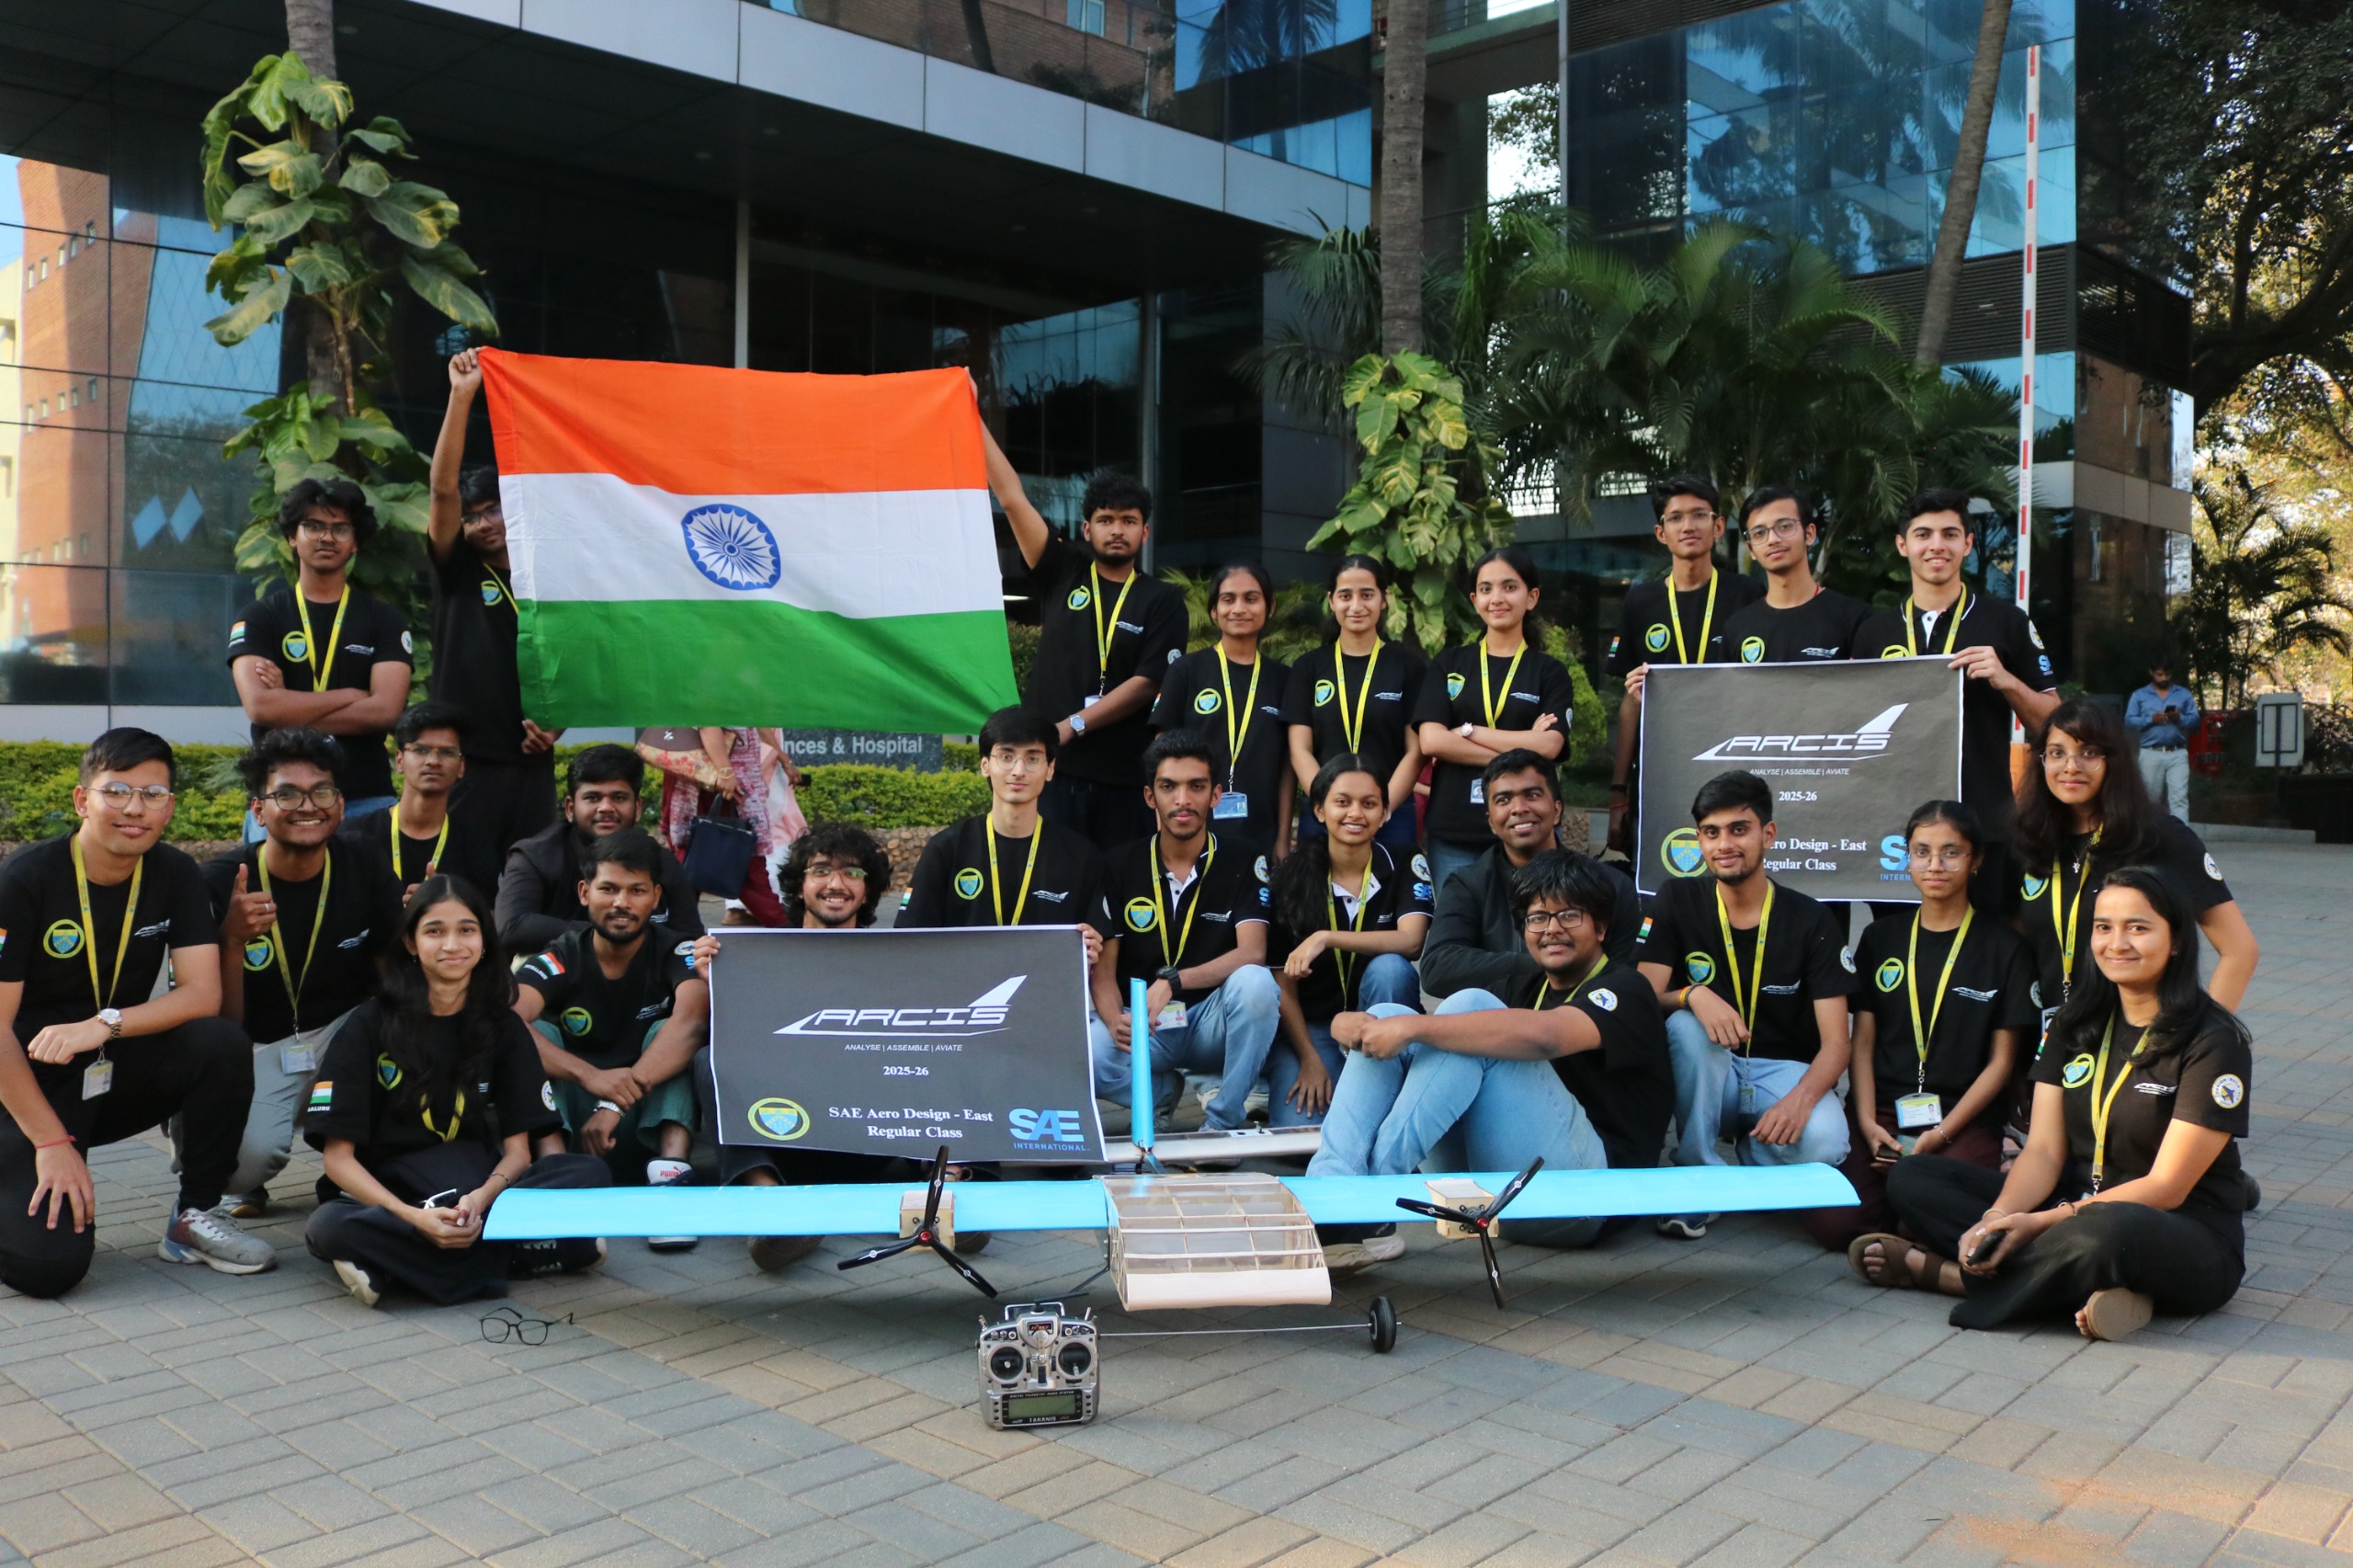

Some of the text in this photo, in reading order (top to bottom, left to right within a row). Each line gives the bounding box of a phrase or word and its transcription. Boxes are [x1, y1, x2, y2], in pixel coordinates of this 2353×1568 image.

[832, 737, 845, 755] &
[852, 736, 923, 758] Hospital
[1725, 734, 1892, 752] ARCIS
[1779, 791, 1818, 801] 2025-26
[1770, 840, 1787, 850] ro
[1790, 838, 1829, 853] Design
[1840, 839, 1867, 851] East
[1804, 858, 1837, 871] Class
[813, 1006, 1010, 1027] ARCIS
[844, 1043, 881, 1051] ANALYSE
[886, 1044, 929, 1052] ASSEMBLE
[935, 1044, 963, 1052] AVIATE
[882, 1065, 929, 1076] 2025-26
[828, 1107, 863, 1119] SAE
[867, 1108, 900, 1119] Aero
[904, 1108, 951, 1122] Design
[962, 1108, 994, 1122] East
[1008, 1108, 1085, 1142] SAE
[867, 1125, 963, 1141] Regular Class
[1013, 1142, 1086, 1152] INTERNATIONAL
